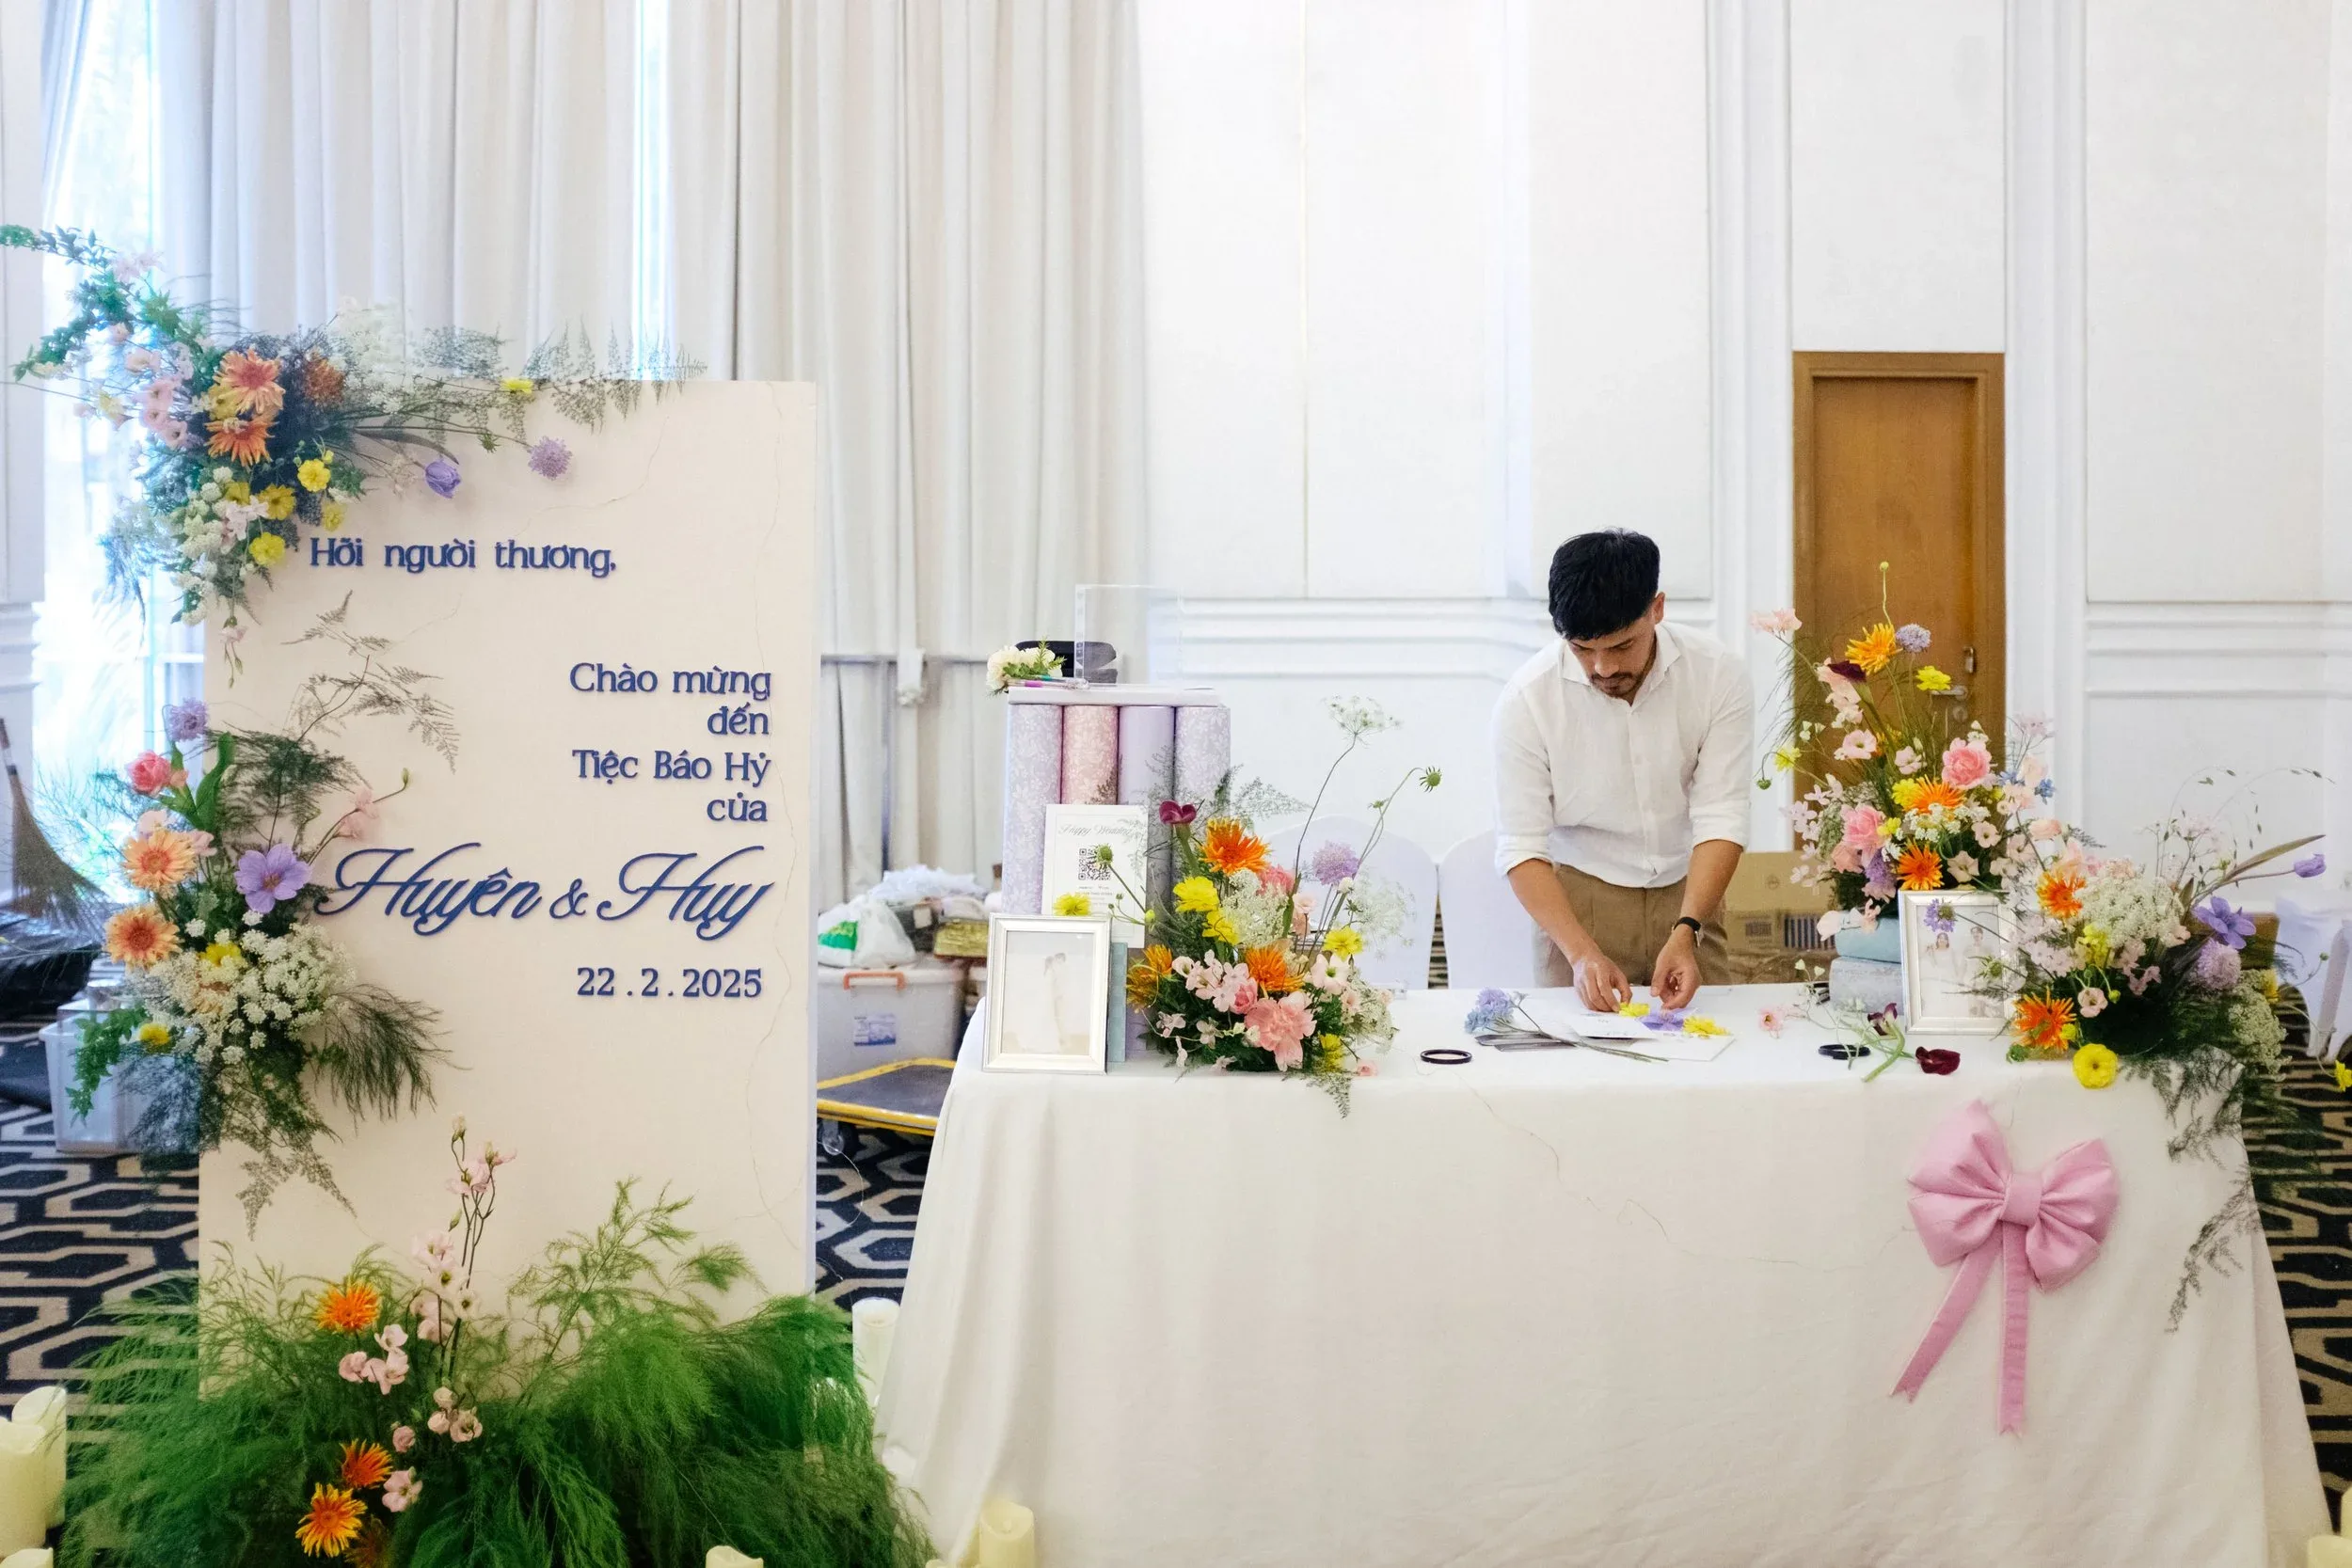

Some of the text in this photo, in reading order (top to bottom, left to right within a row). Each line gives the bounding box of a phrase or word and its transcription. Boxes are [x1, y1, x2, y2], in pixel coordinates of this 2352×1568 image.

[384, 538, 476, 575] người
[495, 539, 617, 578] thương,
[569, 662, 771, 703] Chào mừng
[707, 702, 770, 736] đến
[572, 749, 771, 788] Tiệc Báo Hỷ
[707, 792, 768, 822] của
[313, 842, 774, 942] Huyên & Huy
